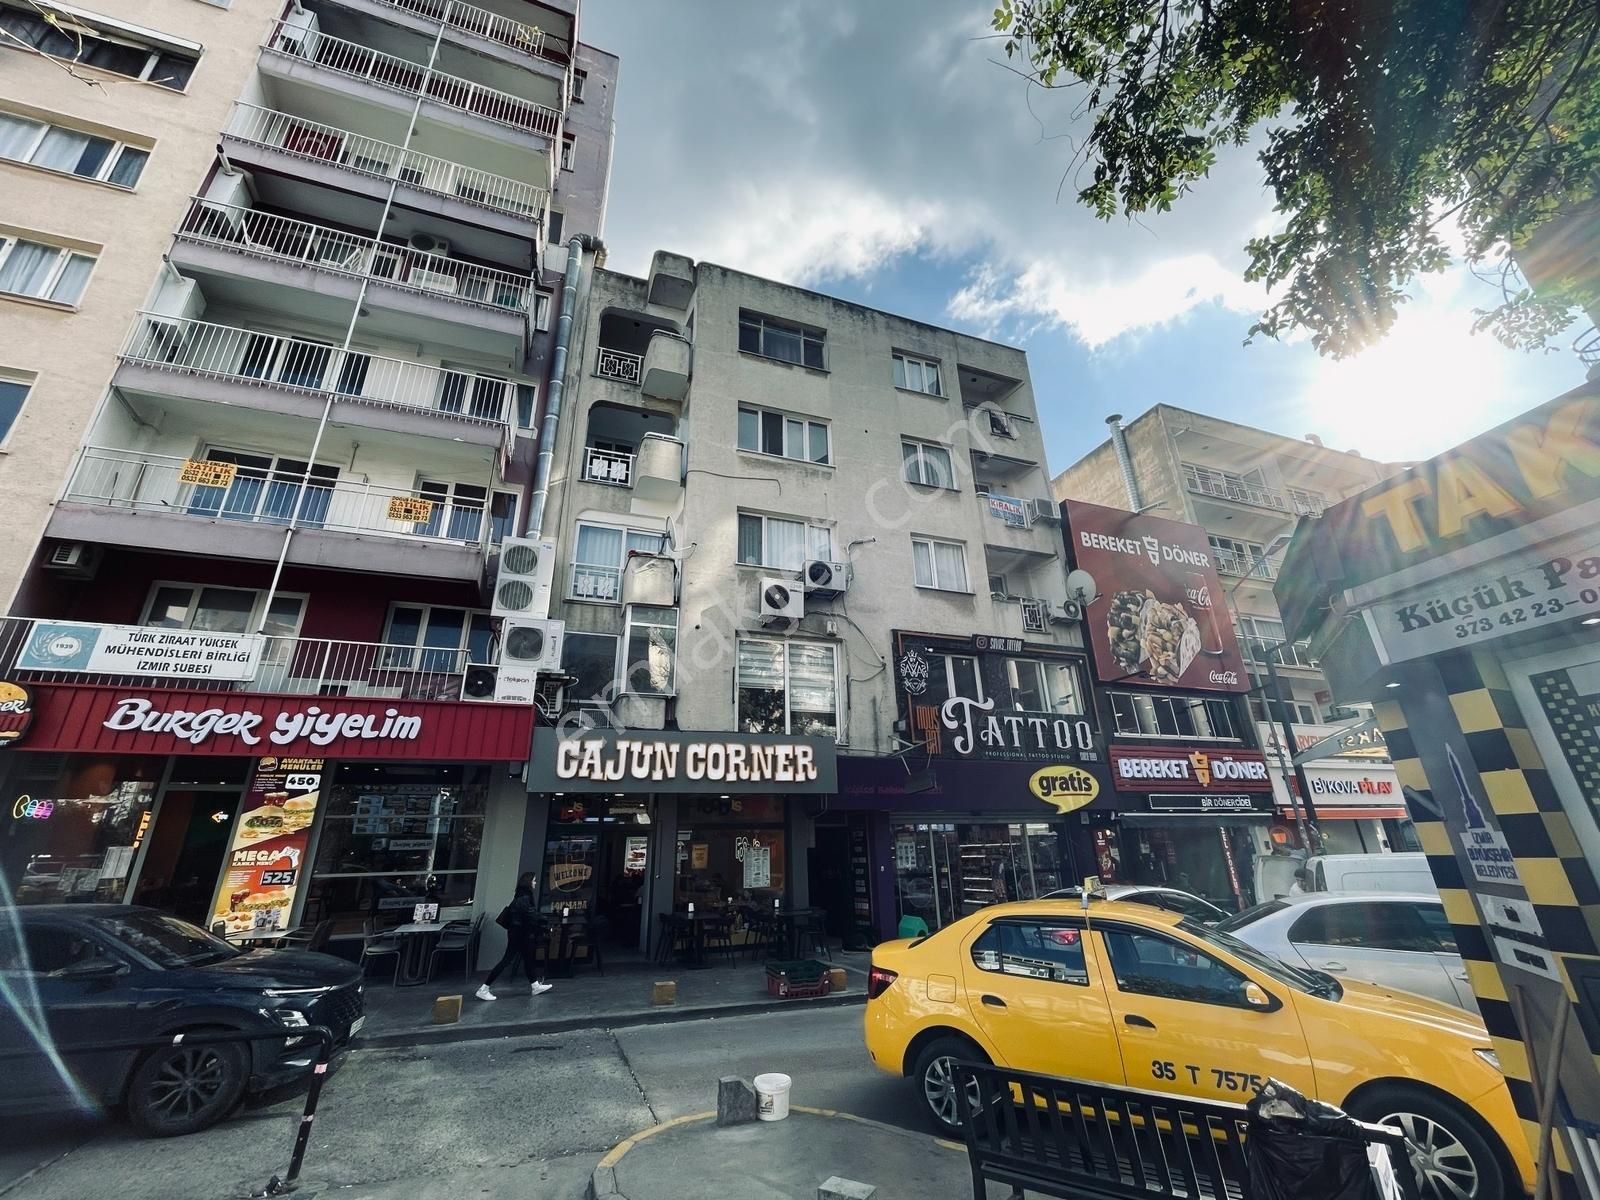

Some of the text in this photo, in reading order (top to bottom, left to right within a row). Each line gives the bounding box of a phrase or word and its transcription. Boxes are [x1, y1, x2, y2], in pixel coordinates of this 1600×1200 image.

[187, 463, 232, 474] SATILIK
[1080, 531, 1210, 568] BEREKET DÖNER
[1455, 587, 1600, 639] 373 42 23-0
[128, 632, 157, 643] TÜRK
[199, 636, 239, 649] YÜKSEK
[104, 643, 252, 663] MÜHENDİSLERİ BİRLİĞİ
[556, 739, 818, 782] CAJUN CORNER
[1118, 756, 1268, 779] BEREKET DÖNER
[1038, 771, 1093, 797] gratis
[233, 850, 281, 862] MEGA
[1151, 1060, 1264, 1093] 35 T 7575
